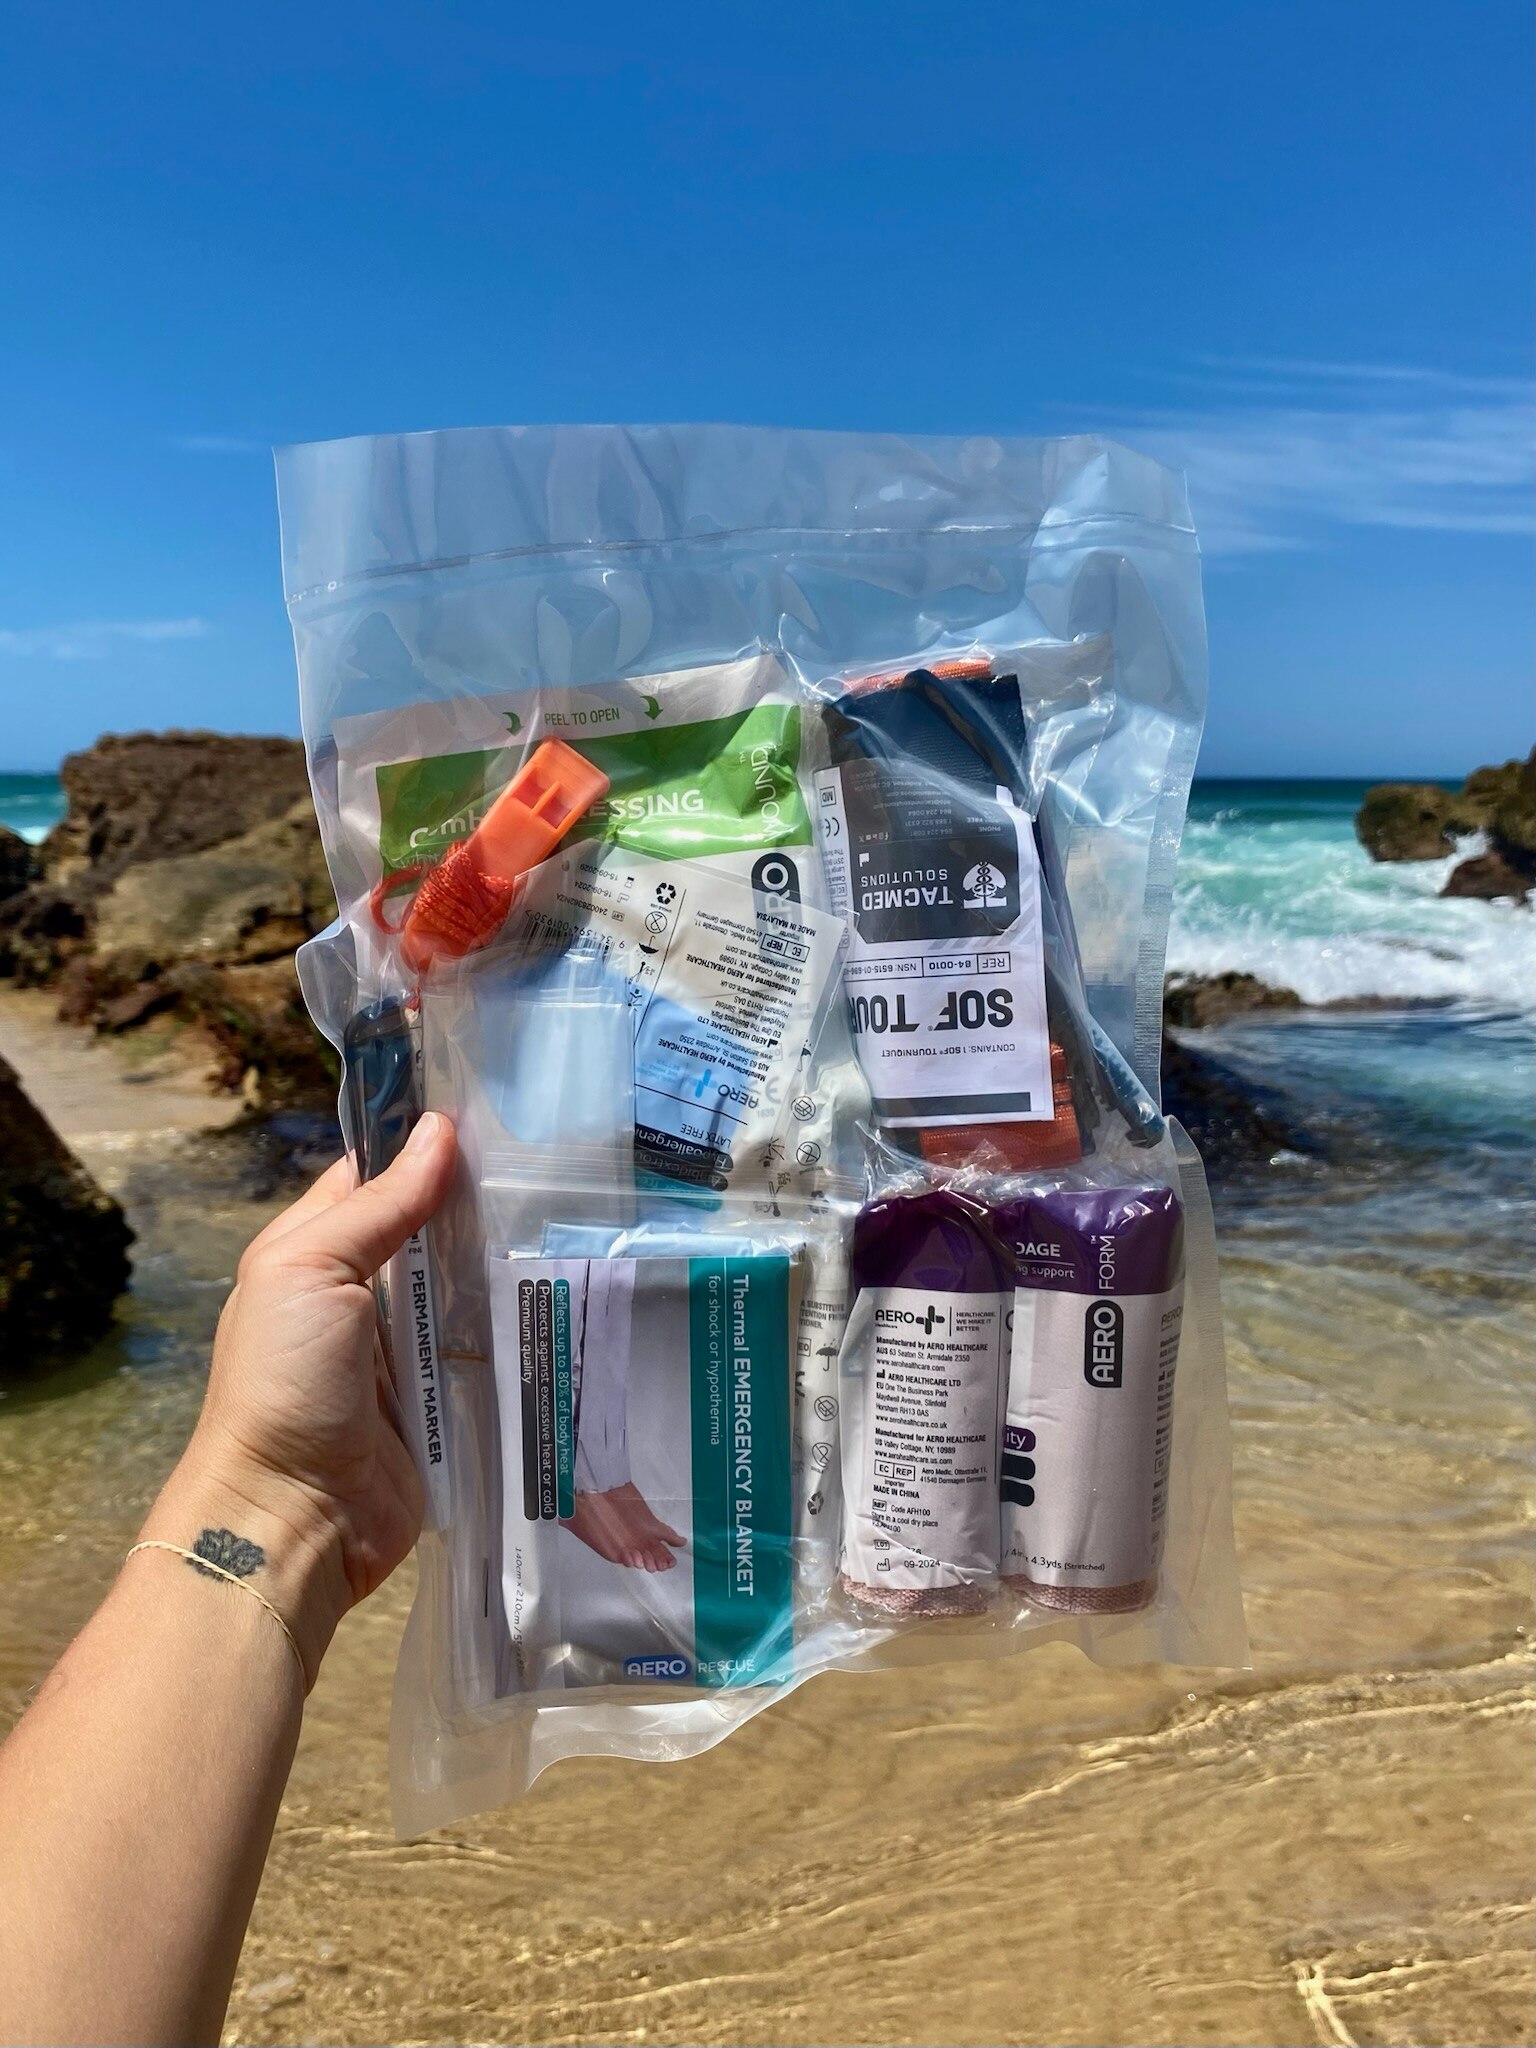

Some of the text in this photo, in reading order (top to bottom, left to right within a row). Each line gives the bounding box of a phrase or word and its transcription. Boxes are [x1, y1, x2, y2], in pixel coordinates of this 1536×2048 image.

[544, 708, 620, 726] PEEL TO OPEN
[821, 791, 832, 802] MD
[859, 868, 947, 886] SOLUTIONS
[861, 885, 953, 910] TACMED
[755, 911, 816, 936] MADE IN MALAYSIA
[766, 938, 801, 956] EC REP
[718, 953, 737, 965] 10989
[894, 957, 1004, 971] REF 84-0010 NSN:
[685, 953, 797, 995] Manufactured for AERO HEALTHCARE
[791, 977, 800, 985] US
[746, 999, 763, 1010] RH13
[696, 1015, 767, 1045] AERO HEALTHCARE LTD
[749, 1022, 760, 1031] The
[678, 1034, 694, 1044] 2350
[772, 1030, 781, 1038] EU
[704, 1031, 773, 1061] www.aerohealthcare.com
[881, 1047, 936, 1056] TOURNIQUET
[968, 1043, 1014, 1052] CONTAINS:
[657, 1038, 766, 1081] Manufactured by AERO HEALTHCARE
[728, 1052, 749, 1065] Seaton
[748, 1059, 757, 1067] 63
[757, 1062, 769, 1071] AUS
[715, 1083, 760, 1109] AERO
[679, 1123, 731, 1147] LATEX FREE
[1032, 1267, 1075, 1279] support
[875, 1309, 914, 1323] AERO
[519, 1286, 533, 1383] Premium quality
[876, 1336, 916, 1347] Manufactured
[918, 1342, 925, 1350] by
[1092, 1306, 1116, 1382] AERO
[890, 1347, 896, 1355] 63
[898, 1349, 916, 1357] Seaton
[412, 1269, 443, 1465] PERMANENT MARKER
[706, 1275, 724, 1445] for shock or hypothermia
[877, 1359, 945, 1372] www.aerohealthcare.com
[554, 1285, 570, 1474] Reflects up to 80% of body heat
[889, 1373, 903, 1381] AERO
[906, 1375, 947, 1386] HEALTHCARE
[908, 1386, 933, 1396] Business
[935, 1389, 948, 1397] Park
[536, 1286, 554, 1513] Protects against excessive heat or cold
[900, 1407, 915, 1415] RH13
[876, 1415, 947, 1428] www.aerohealthcare.co.uk
[731, 1274, 755, 1596] Thermal EMERGENCY BLANKET
[875, 1428, 913, 1440] Manufactured
[916, 1434, 924, 1442] for
[947, 1435, 986, 1443] HEALTHCARE
[875, 1450, 952, 1465] www.aerohealthcare.us.com
[880, 1465, 889, 1473] EC
[874, 1485, 919, 1499] MADE IN CHINA
[891, 1505, 930, 1516] Code AFH100
[897, 1517, 909, 1525] cool
[911, 1517, 920, 1527] dry
[922, 1519, 938, 1527] place
[904, 1560, 940, 1568] 09-2024
[1031, 1556, 1061, 1568] 4.3yds
[512, 1547, 524, 1624] 140cm 210cm
[627, 1659, 755, 1676] AERO RESCUE
